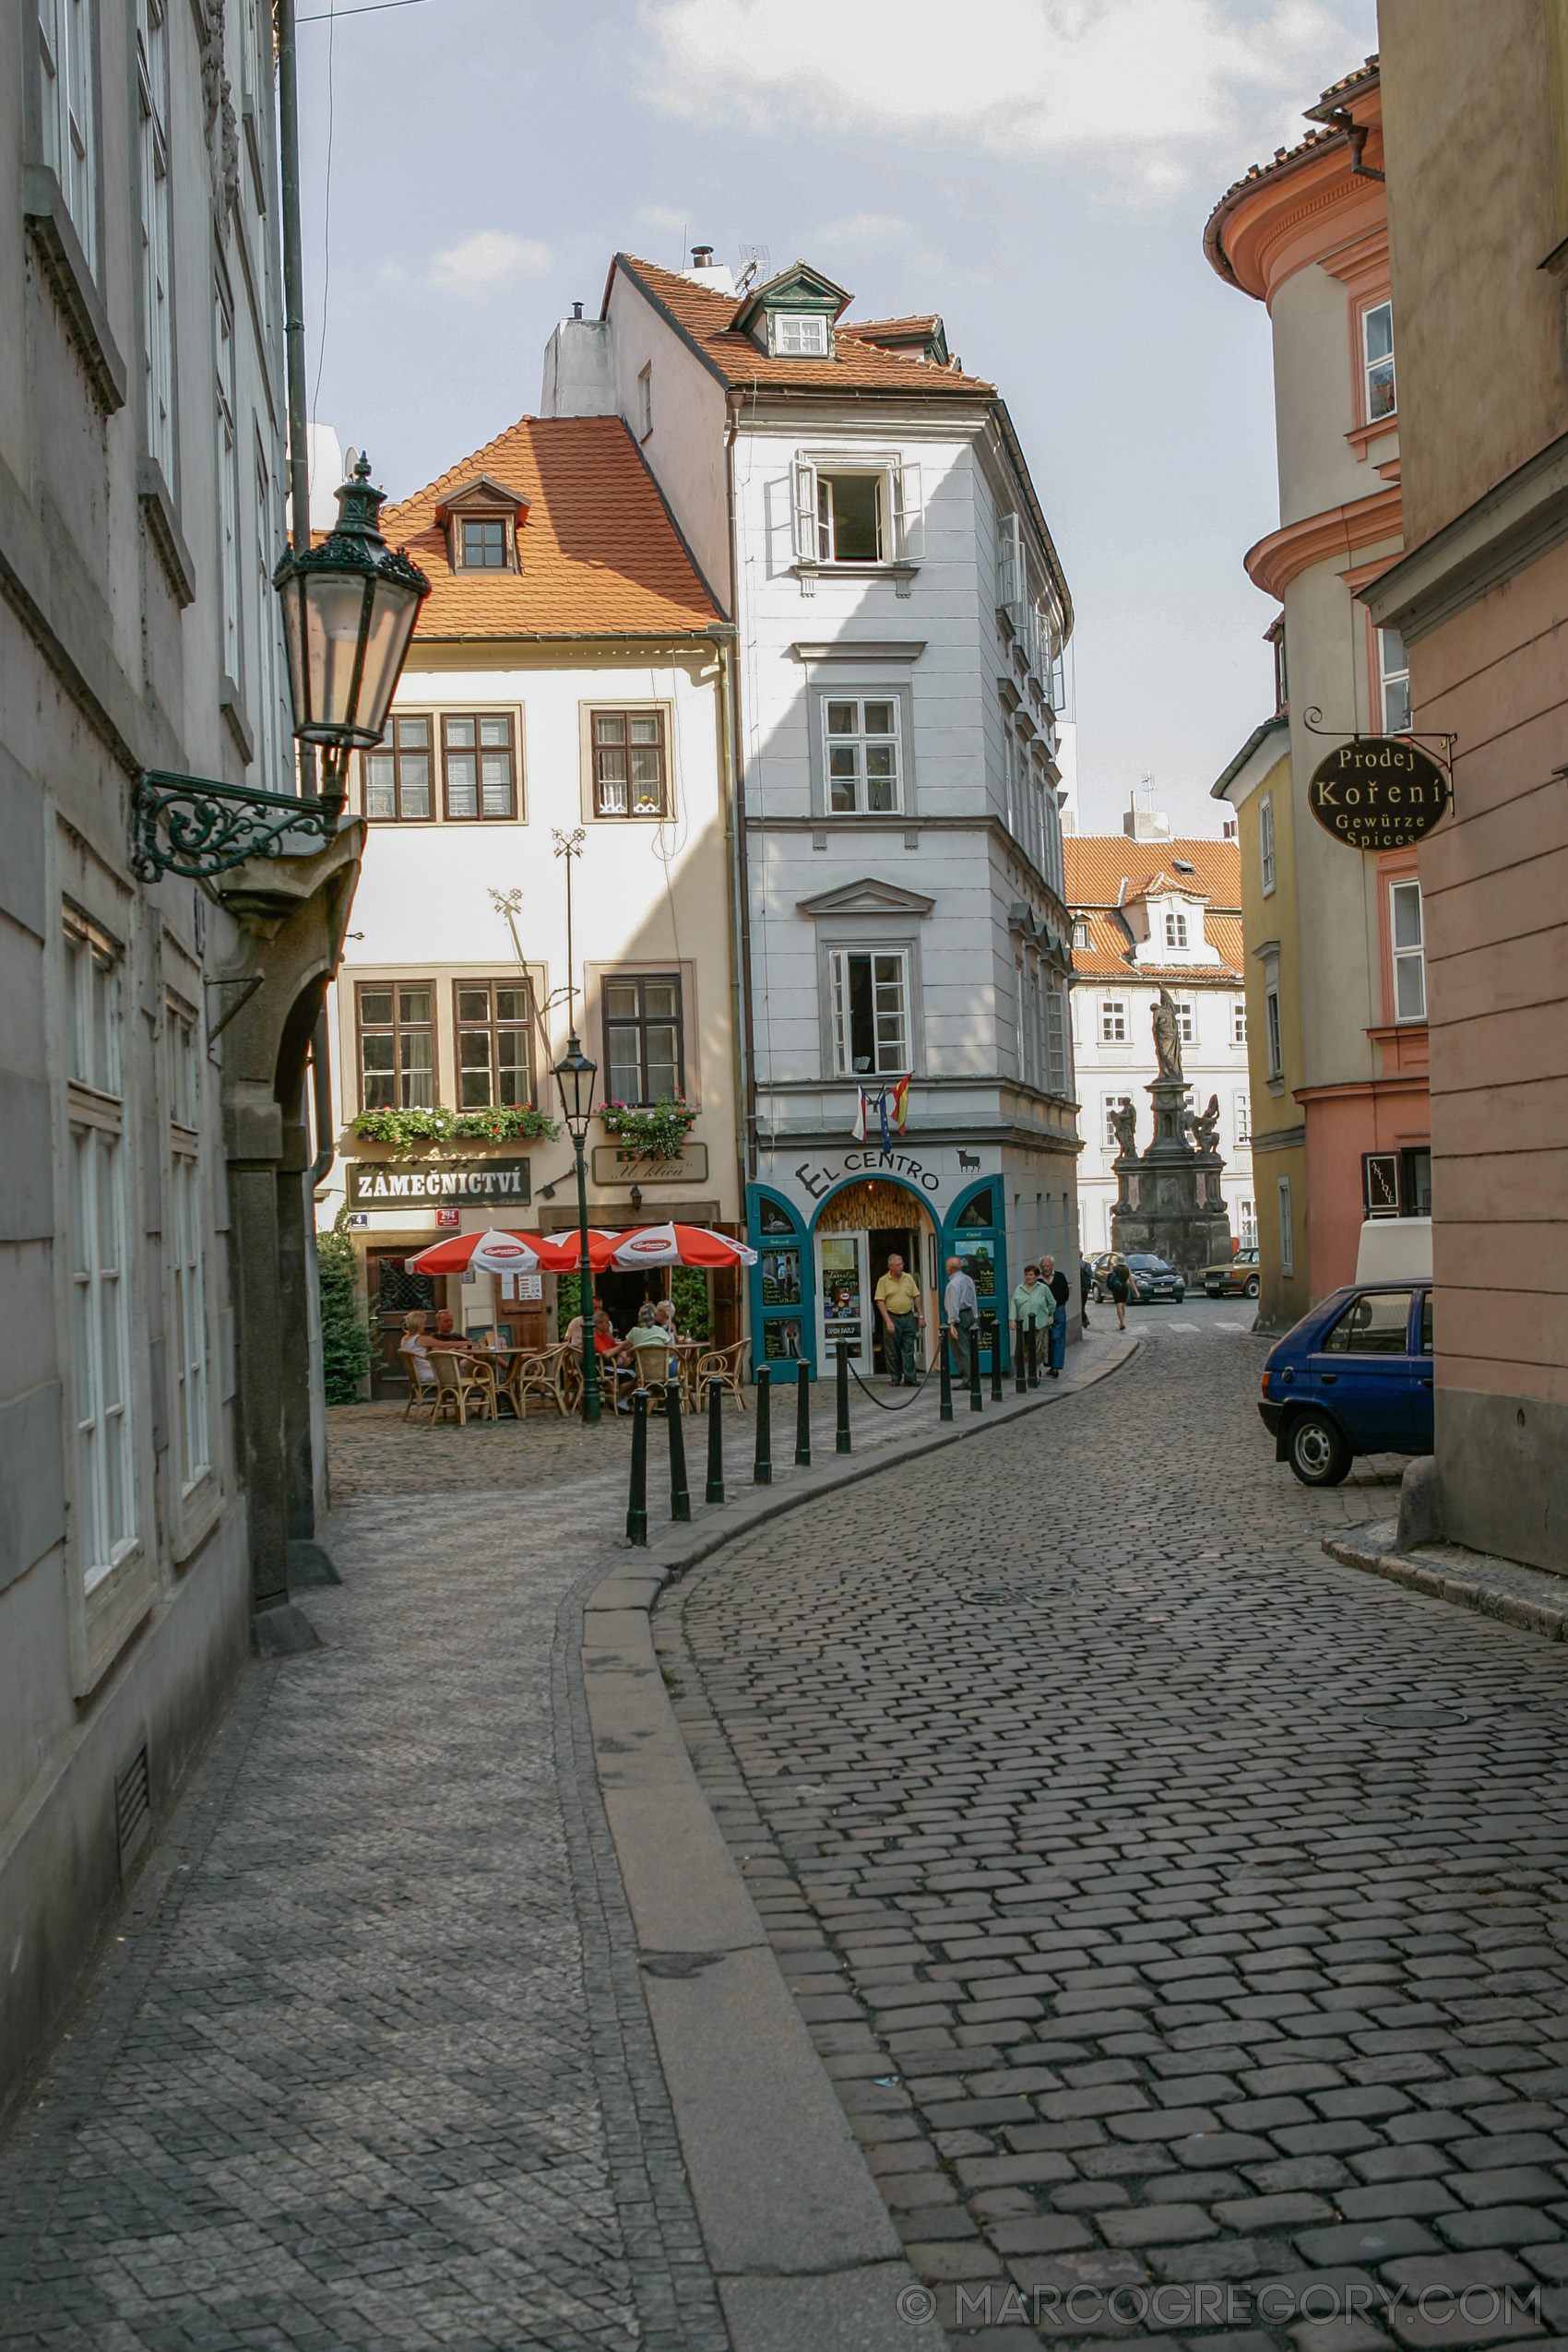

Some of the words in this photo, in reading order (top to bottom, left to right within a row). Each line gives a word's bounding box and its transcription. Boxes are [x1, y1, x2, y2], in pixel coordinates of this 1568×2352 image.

[1338, 748, 1415, 771] Prodej
[1316, 778, 1441, 805] Koření
[1336, 814, 1425, 829] Gewürze
[1347, 832, 1415, 848] Spices
[358, 1166, 521, 1197] ZÁMEČNICTVÍ
[795, 1163, 840, 1199] EL
[844, 1152, 940, 1191] CENTRO
[1372, 1161, 1395, 1203] ANTIQUE
[356, 1215, 362, 1224] 4
[440, 1210, 455, 1219] 294
